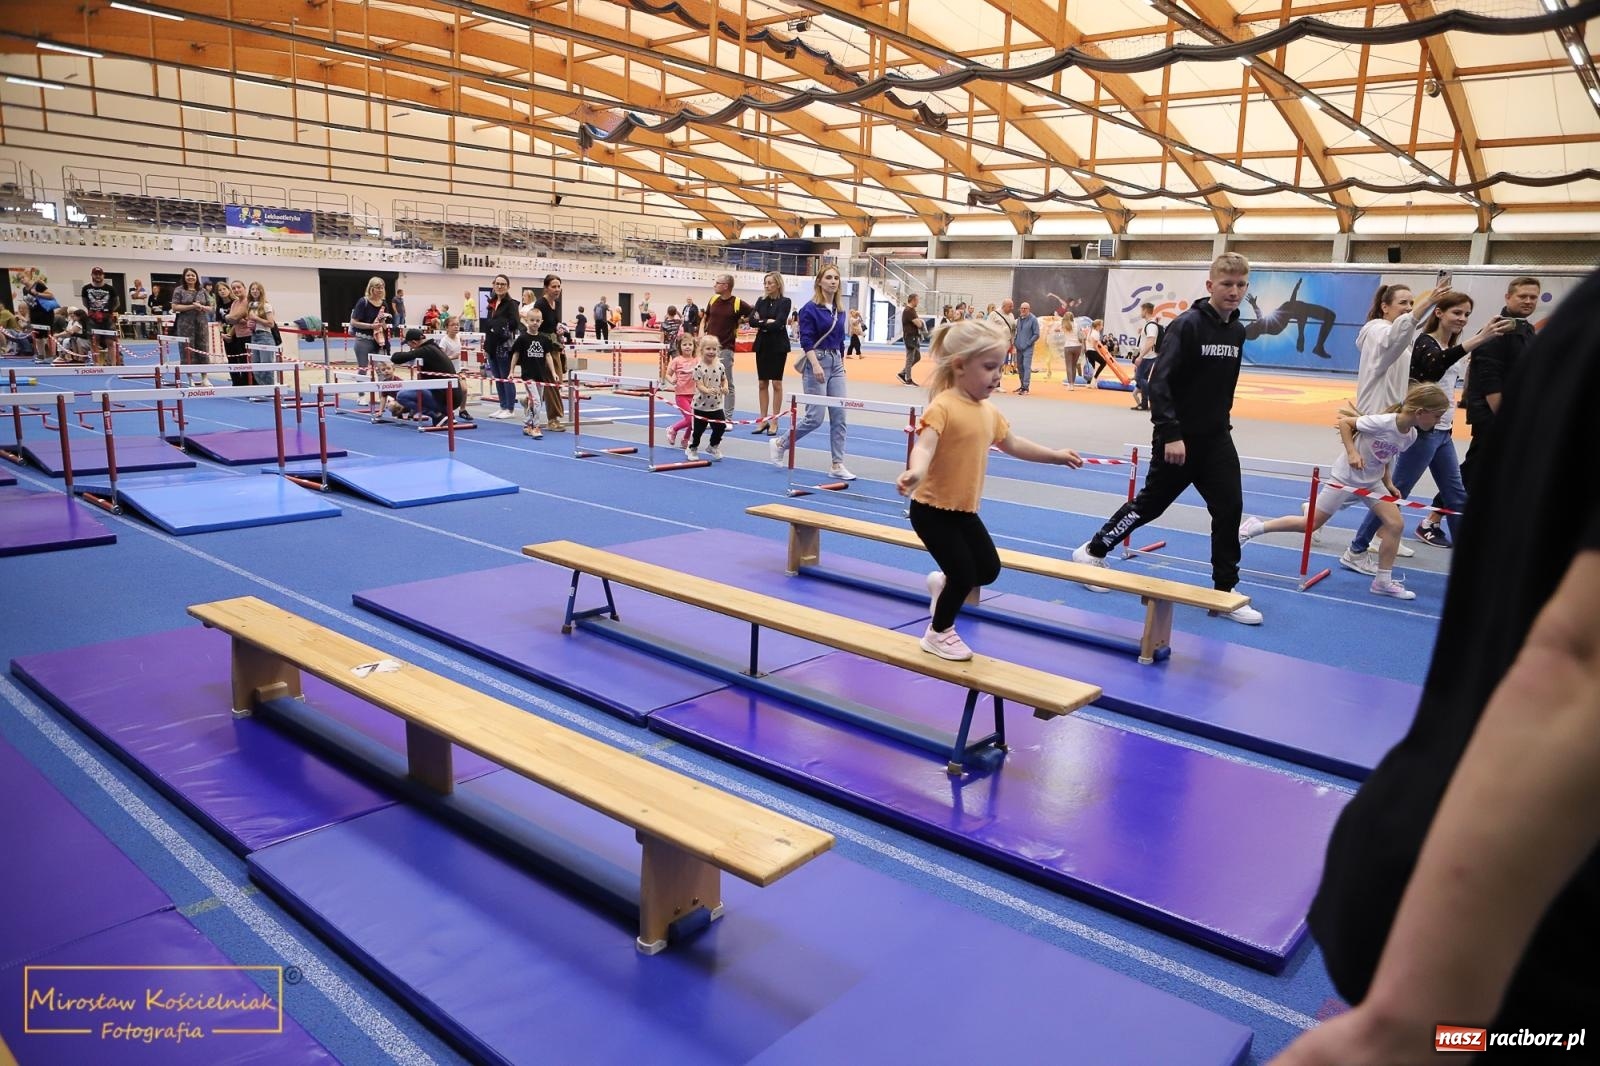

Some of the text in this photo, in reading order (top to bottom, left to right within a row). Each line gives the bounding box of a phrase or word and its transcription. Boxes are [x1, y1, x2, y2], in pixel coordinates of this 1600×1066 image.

[1119, 334, 1137, 346] Ra
[1201, 344, 1239, 358] WRESTL
[188, 390, 215, 398] polanik
